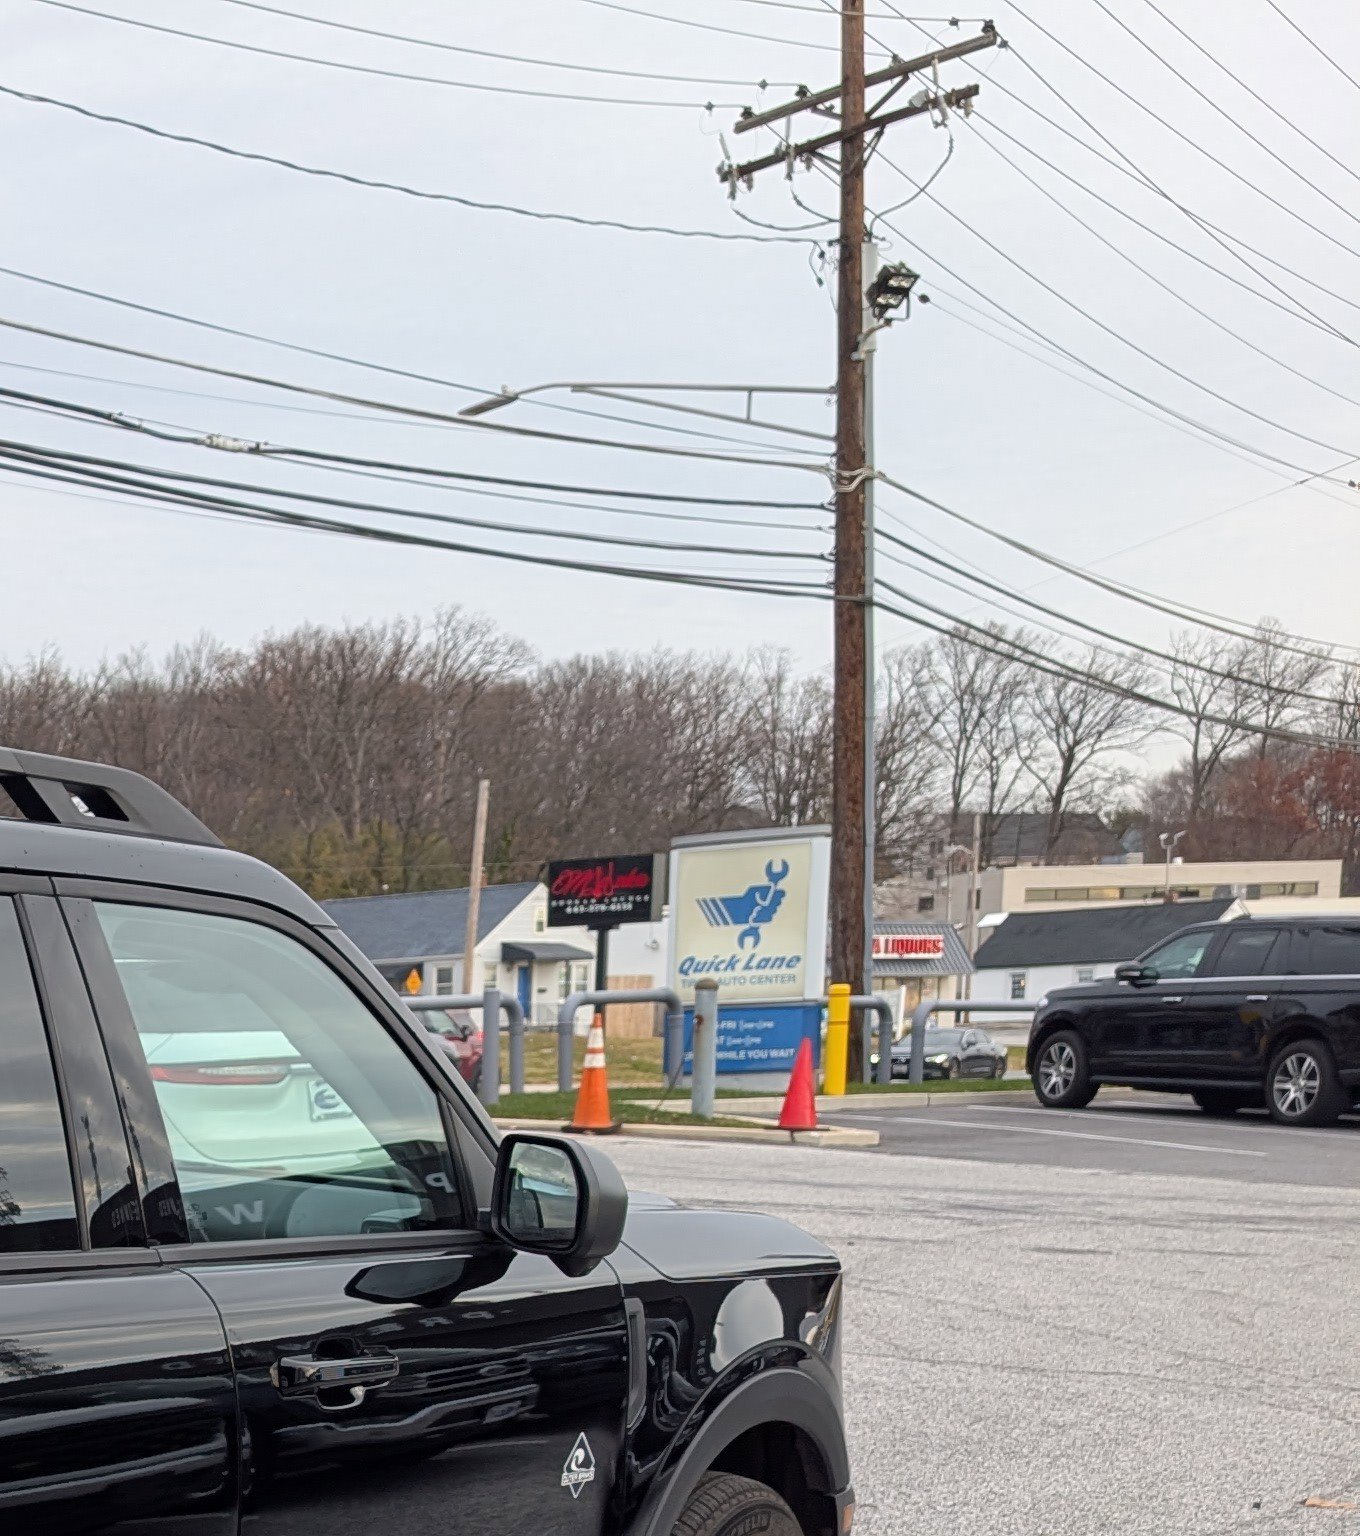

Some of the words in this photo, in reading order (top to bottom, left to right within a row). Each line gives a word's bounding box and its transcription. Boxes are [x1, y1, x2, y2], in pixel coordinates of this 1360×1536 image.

[884, 938, 943, 957] LIQUORS
[678, 954, 739, 976] Quick
[742, 952, 801, 972] Lane
[748, 974, 796, 985] CENTER
[747, 1049, 768, 1060] YOU
[769, 1047, 795, 1059] WAIT
